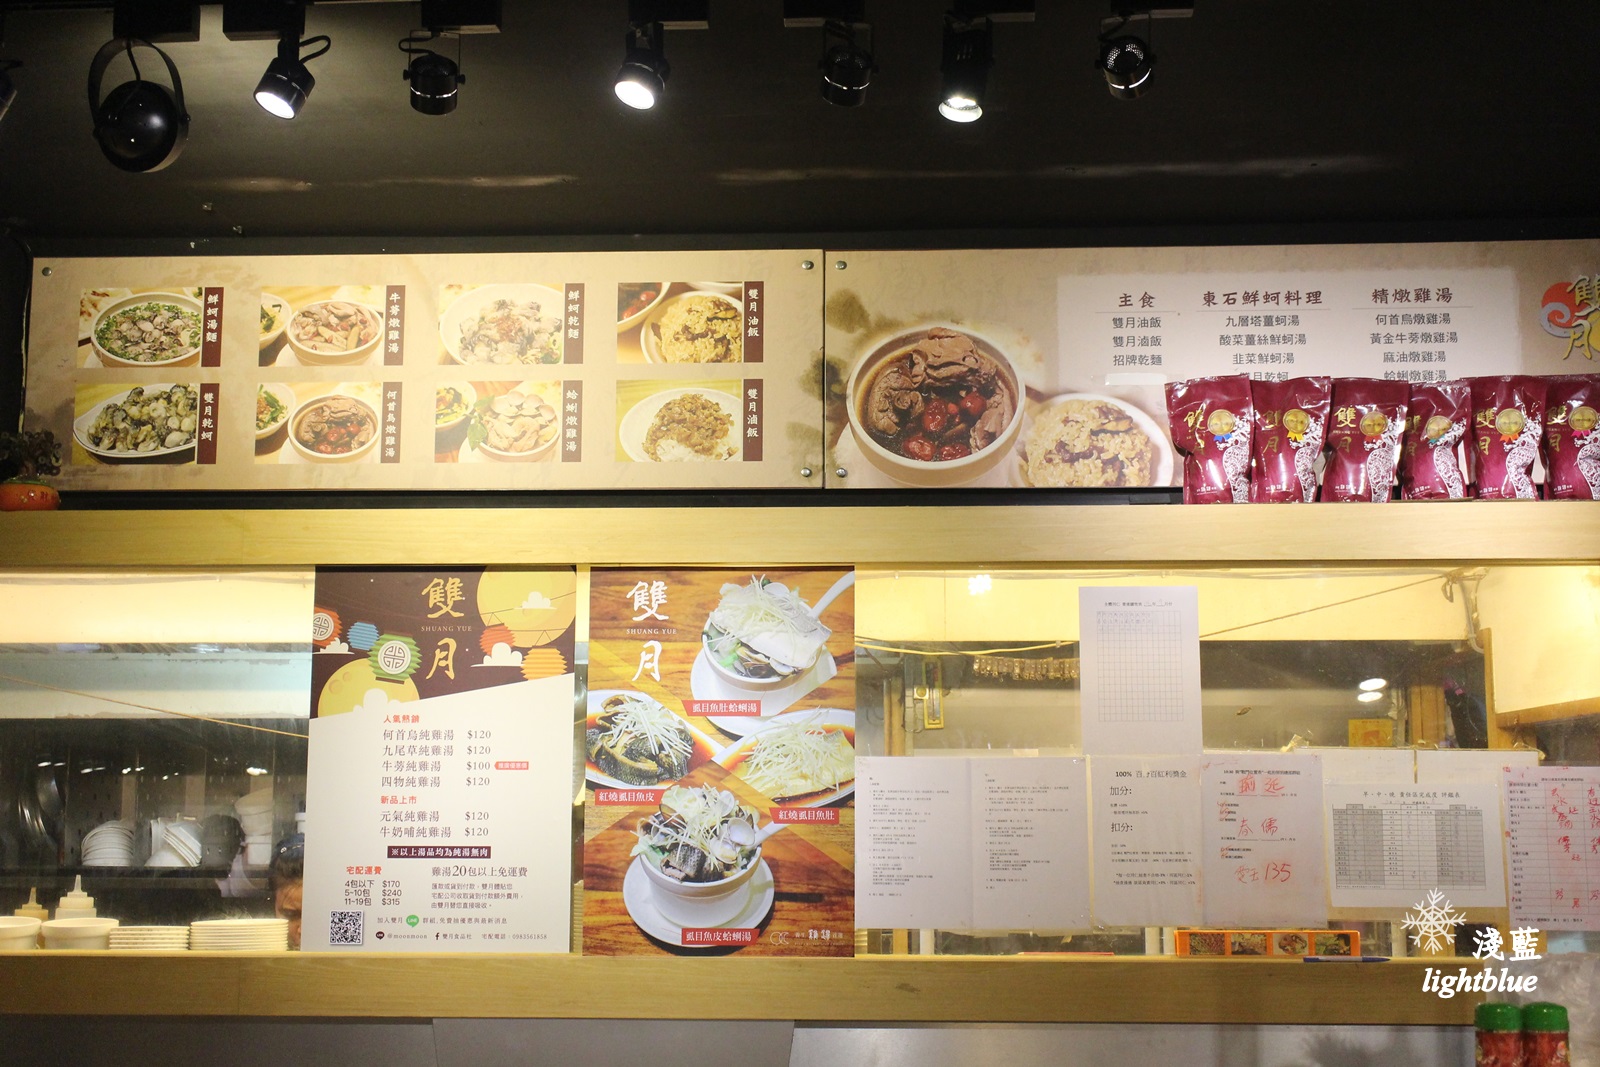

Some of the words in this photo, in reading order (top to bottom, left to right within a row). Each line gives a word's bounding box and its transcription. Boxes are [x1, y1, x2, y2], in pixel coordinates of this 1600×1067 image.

[1118, 291, 1156, 308] 主食
[1202, 289, 1323, 307] 東石鮮蚵料理
[1372, 287, 1452, 304] 精燉雞湯
[206, 293, 219, 343] 鮮蚵湯麵
[567, 290, 580, 339] 鮮蚵乾麵
[747, 288, 759, 337] 雙月油飯
[387, 292, 401, 353] 牛蒡燉雞湯
[1112, 317, 1161, 329] 雙月油飯
[1225, 315, 1300, 327] 九層塔薑蚵湯
[1375, 313, 1451, 325] 何首烏燉雞湯
[1112, 335, 1162, 347] 雙月滷飯
[1219, 333, 1306, 346] 酸菜薑絲鮮蚵湯
[1370, 331, 1458, 344] 黃金牛蒡燉雞湯
[1113, 354, 1162, 366] 招牌乾麵
[1232, 352, 1294, 365] 韭菜鮮蚵湯
[1383, 351, 1446, 363] 麻油燉雞湯
[1239, 371, 1289, 381] 月乾蚵
[201, 392, 215, 441] 雙月乾蚵
[747, 388, 759, 438] 雙月滷飯
[385, 390, 398, 457] 何首烏燉雞湯
[566, 389, 578, 452] 蛤蜊燉雞湯
[692, 702, 757, 713] 虱目魚肚蛤蜊湯
[383, 715, 420, 723] 人氣熱銷
[383, 729, 454, 741] 何首烏純雞湯
[467, 730, 491, 740] $120
[382, 745, 454, 756] 九尾草純雞湯
[466, 745, 491, 755] $120
[382, 761, 441, 772] 牛蒡純雞湯
[466, 761, 490, 771] $100
[381, 776, 441, 788] 四物純雞湯
[466, 777, 490, 787] $120
[380, 795, 417, 804] 新品上市
[599, 791, 654, 802] 紅燒虱目魚皮
[380, 810, 440, 822] 元氣純雞湯
[465, 811, 489, 821] $120
[778, 810, 835, 821] 紅燒虱目魚肚
[464, 827, 489, 837] $120
[346, 866, 382, 875] 宅配運費
[431, 865, 528, 877] 雞湯20包以上免運費
[1264, 862, 1291, 882] 135
[345, 880, 375, 888] 4包以下
[382, 880, 400, 888] $170
[381, 889, 402, 897] $240
[381, 898, 400, 906] $315
[686, 931, 751, 942] 虱目魚皮蛤蜊湯
